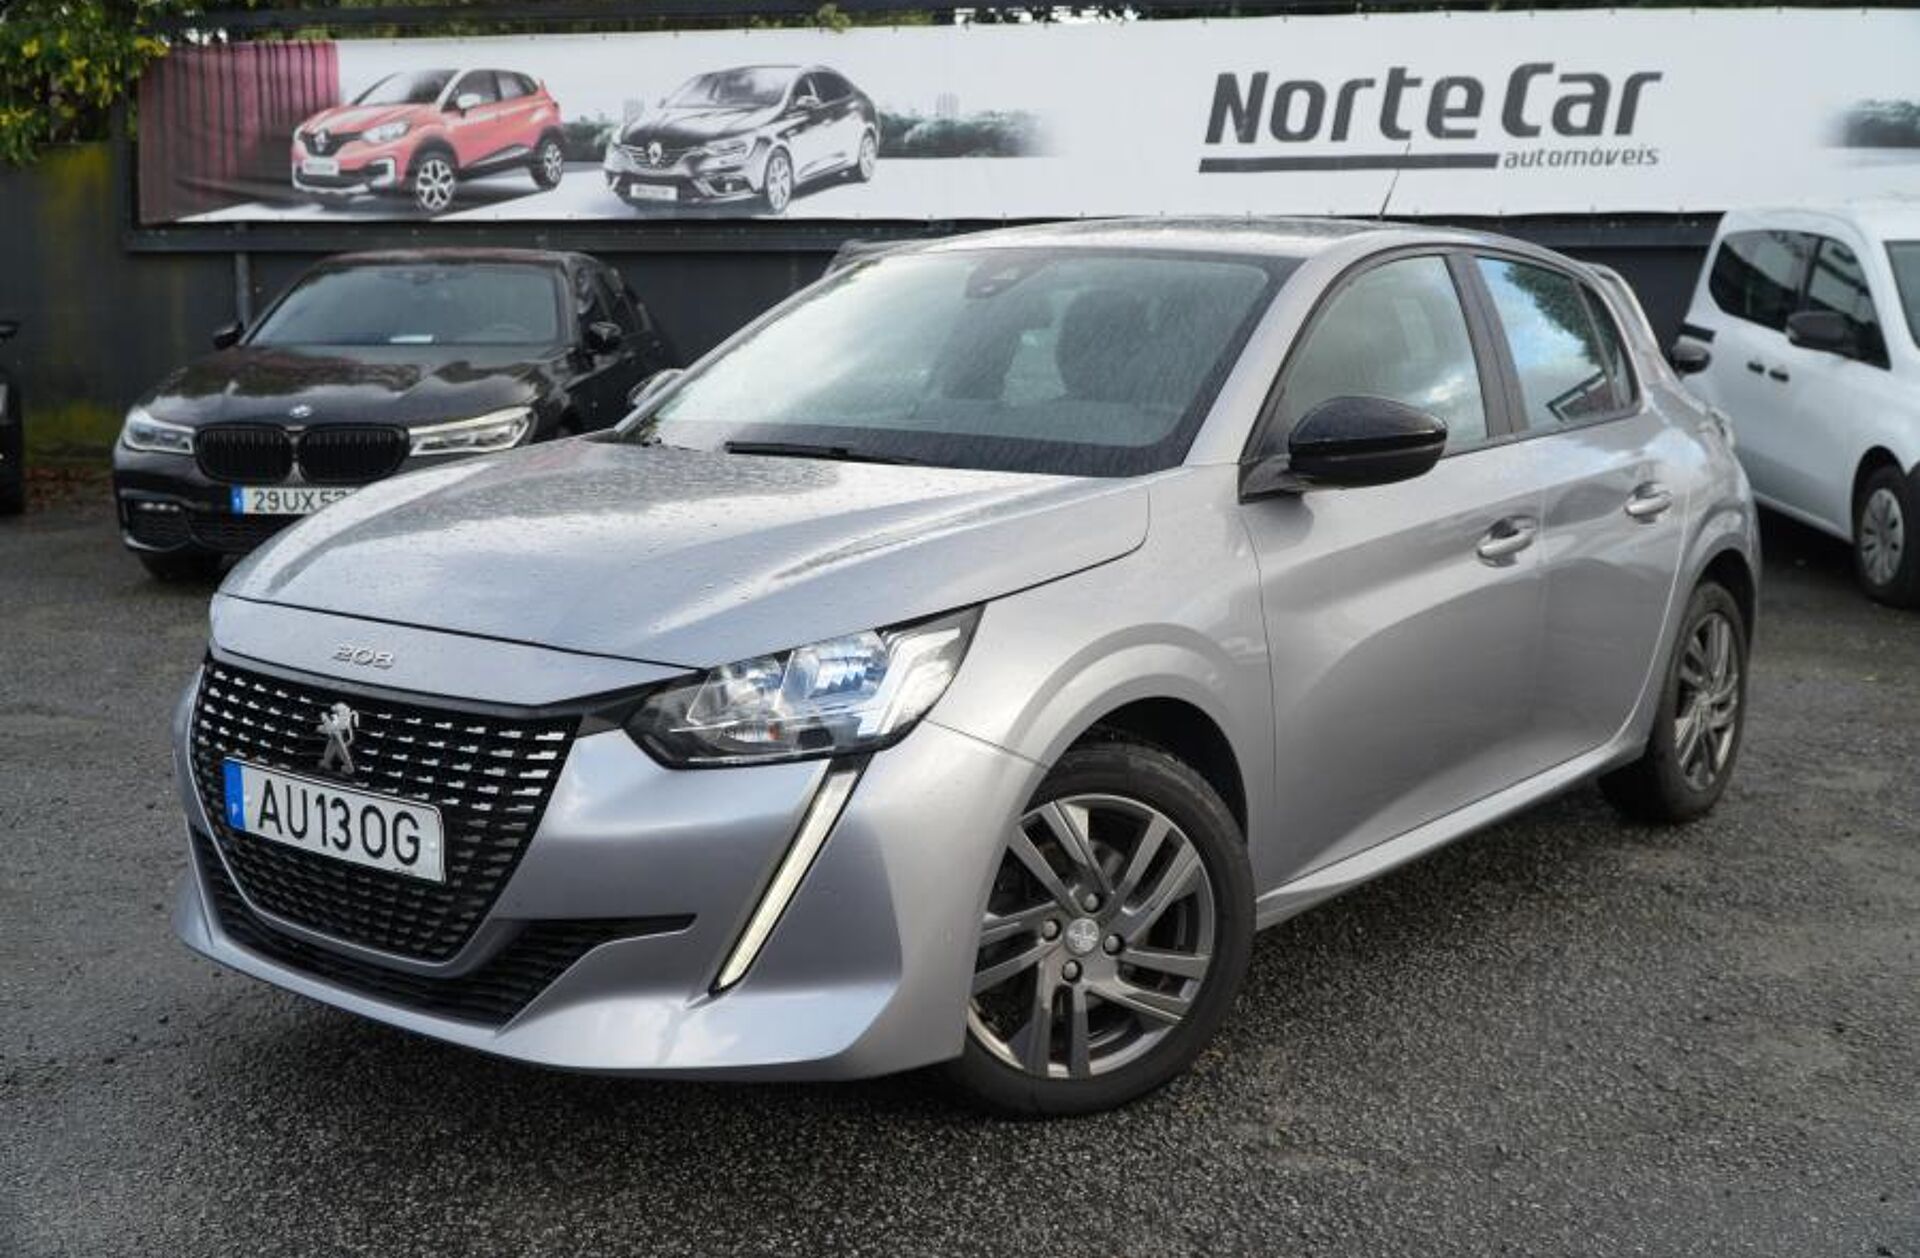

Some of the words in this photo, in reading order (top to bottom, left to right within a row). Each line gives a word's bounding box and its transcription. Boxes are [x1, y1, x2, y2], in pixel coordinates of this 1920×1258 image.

[1204, 67, 1485, 144] Norte
[1500, 62, 1664, 138] Car
[1504, 144, 1659, 169] automóveis
[332, 643, 394, 670] 208
